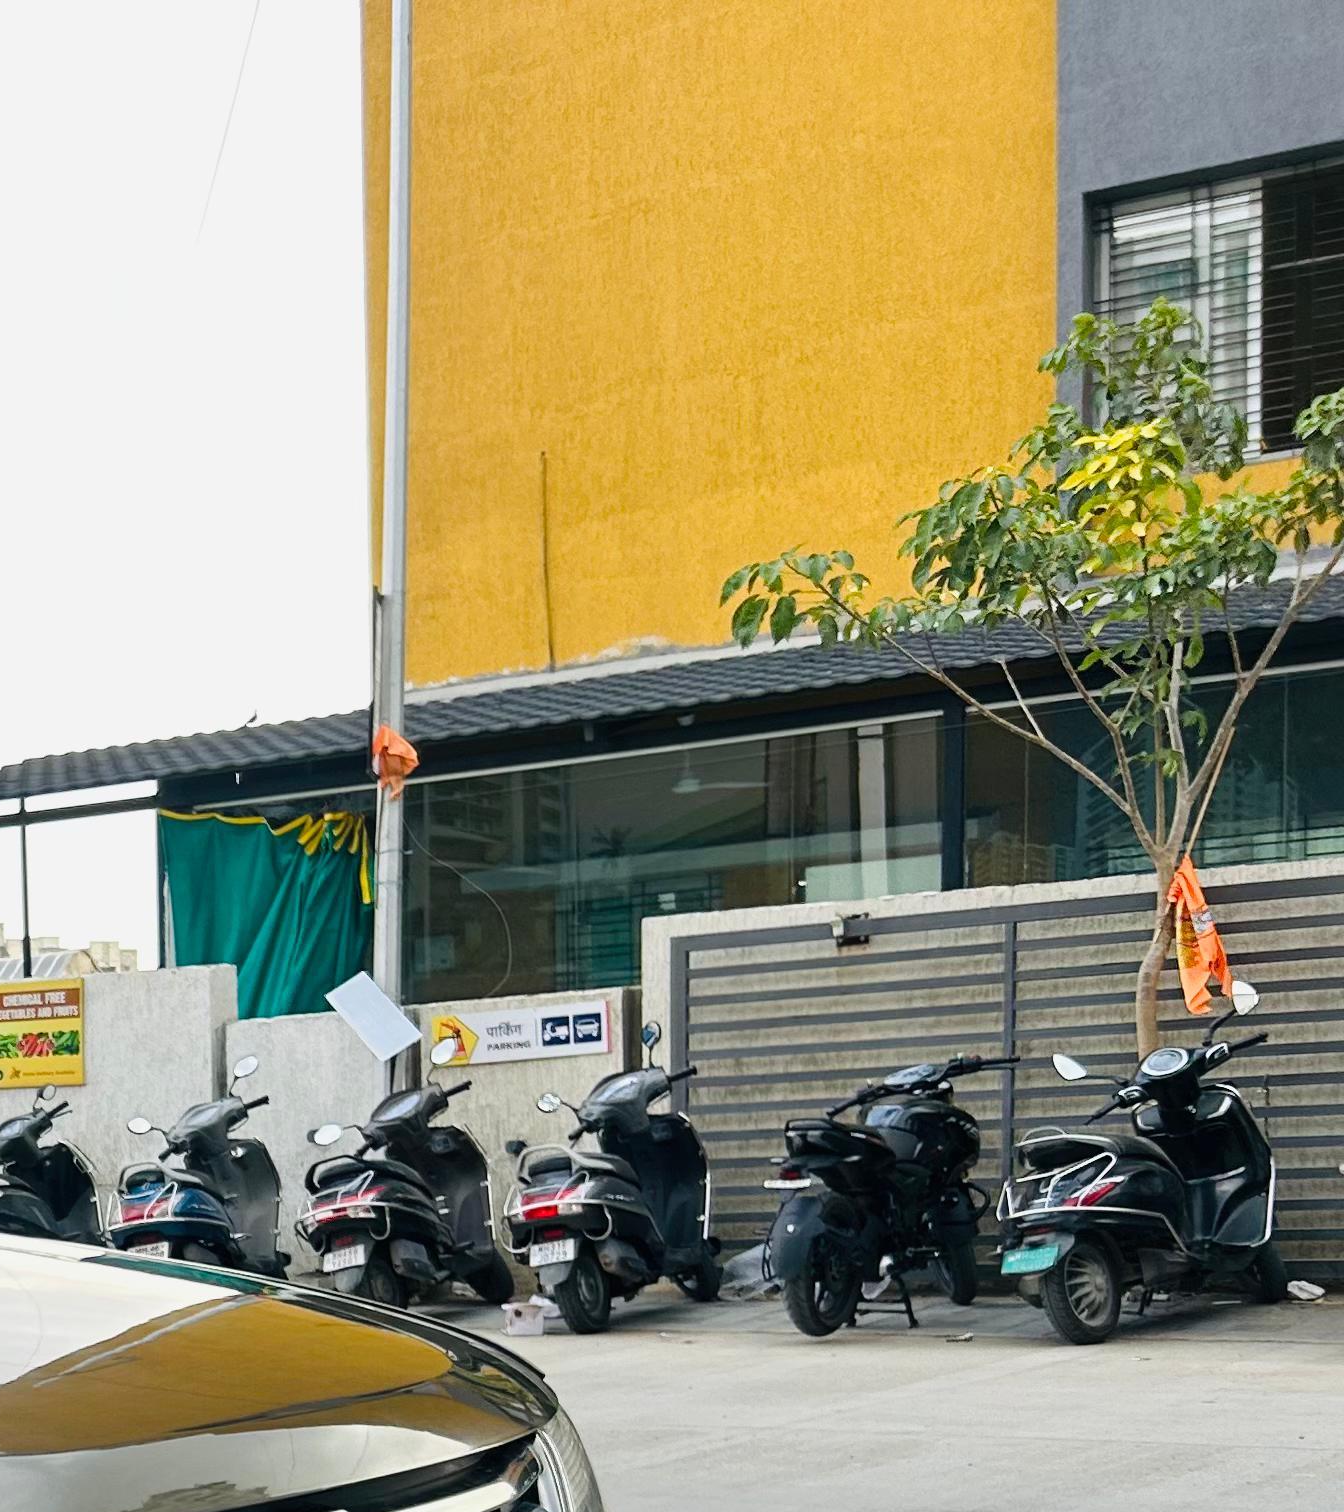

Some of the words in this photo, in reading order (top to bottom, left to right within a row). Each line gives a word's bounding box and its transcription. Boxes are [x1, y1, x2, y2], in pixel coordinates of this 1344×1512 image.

[53, 1005, 79, 1017] FRUITS
[486, 1021, 522, 1037] पार्किंग
[486, 1040, 531, 1051] PARKING
